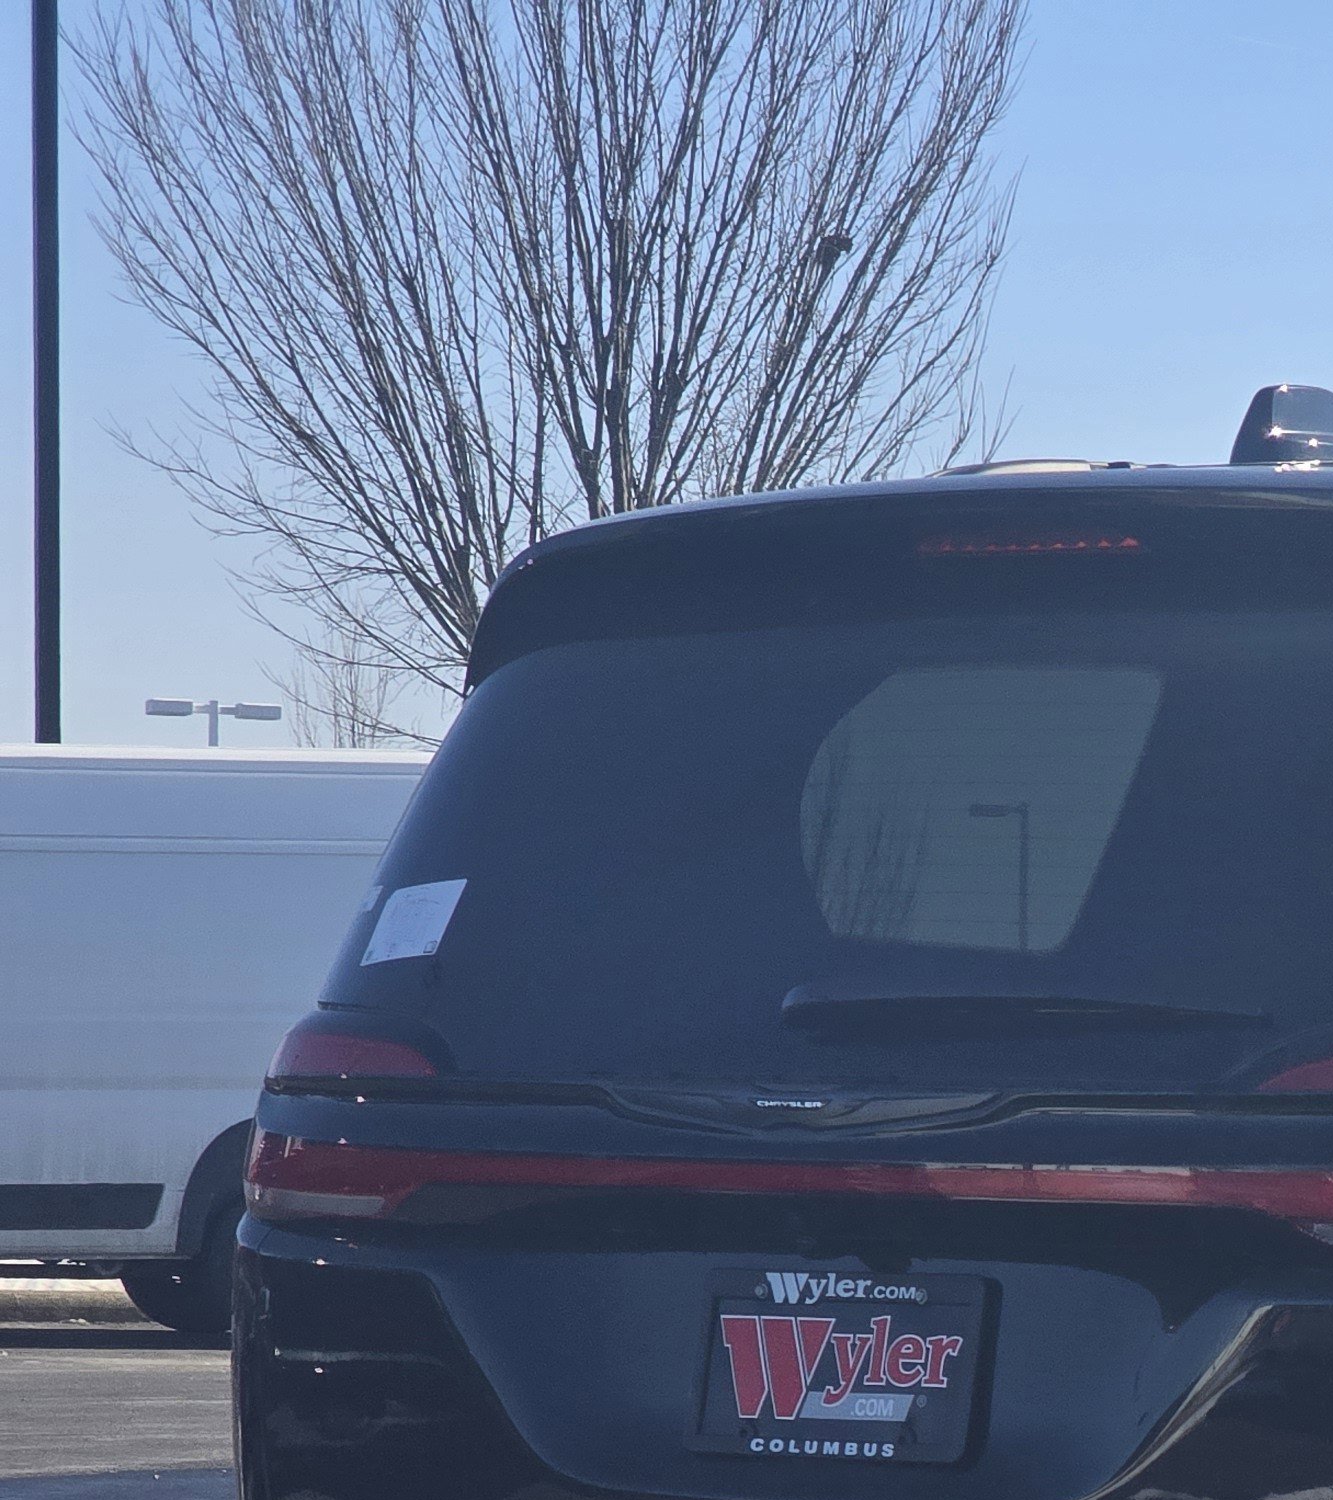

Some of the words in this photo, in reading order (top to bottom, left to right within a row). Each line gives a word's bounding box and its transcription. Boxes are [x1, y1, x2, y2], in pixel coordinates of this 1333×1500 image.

[756, 1100, 823, 1108] CHRYSLER
[720, 1315, 963, 1421] Wyler
[750, 1438, 895, 1458] COLUMBUS
